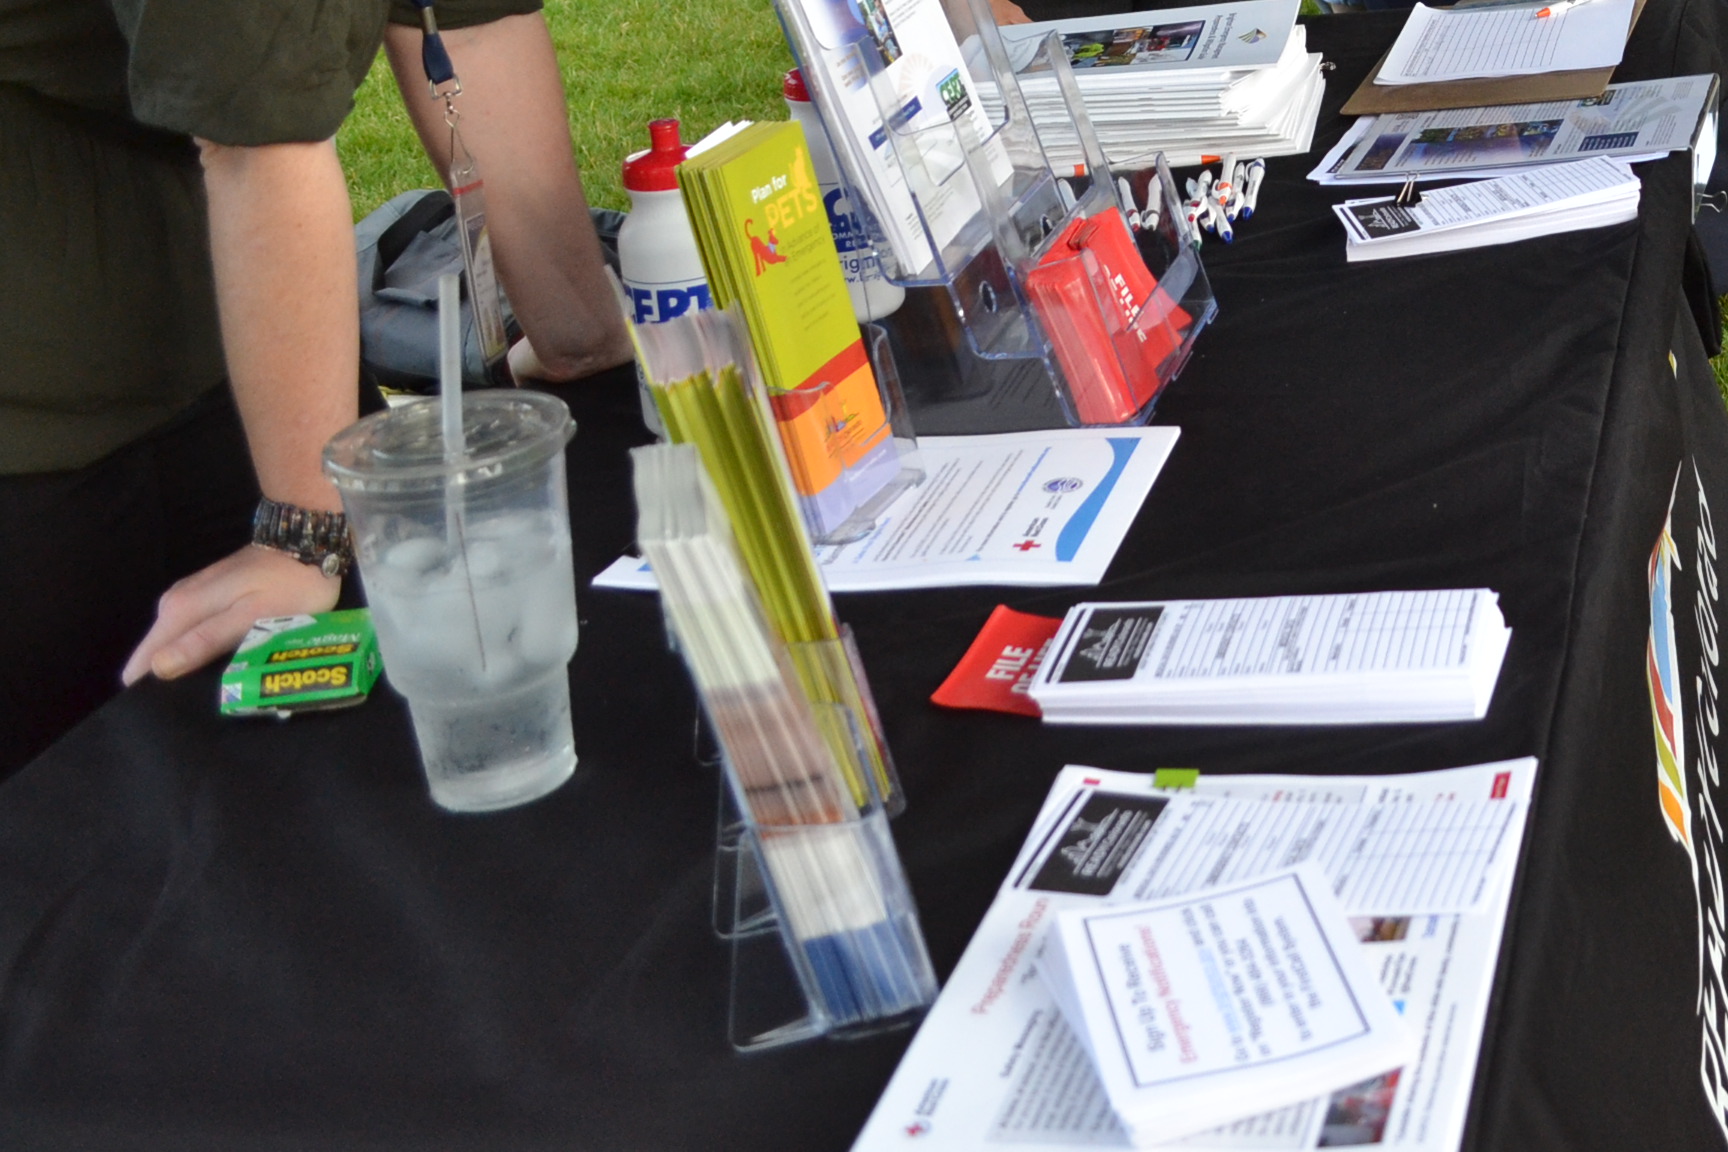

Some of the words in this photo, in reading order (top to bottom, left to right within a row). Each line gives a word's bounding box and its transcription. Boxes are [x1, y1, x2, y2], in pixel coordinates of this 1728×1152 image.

[751, 186, 773, 204] Plan
[772, 174, 788, 189] for
[764, 187, 818, 232] PETS
[626, 284, 713, 325] ERT
[1114, 273, 1143, 317] FILE
[1020, 517, 1040, 536] American
[270, 643, 355, 662] Scotch
[984, 644, 1033, 679] FILE
[264, 665, 348, 693] Scotch
[1250, 915, 1280, 966] information
[971, 931, 1029, 1015] Preparedness
[1118, 943, 1141, 989] Receive
[1138, 925, 1171, 997] Notifications!
[1129, 989, 1148, 1004] To
[1137, 1006, 1156, 1024] Up
[1144, 1024, 1167, 1053] Sign
[1164, 999, 1198, 1064] Emergency
